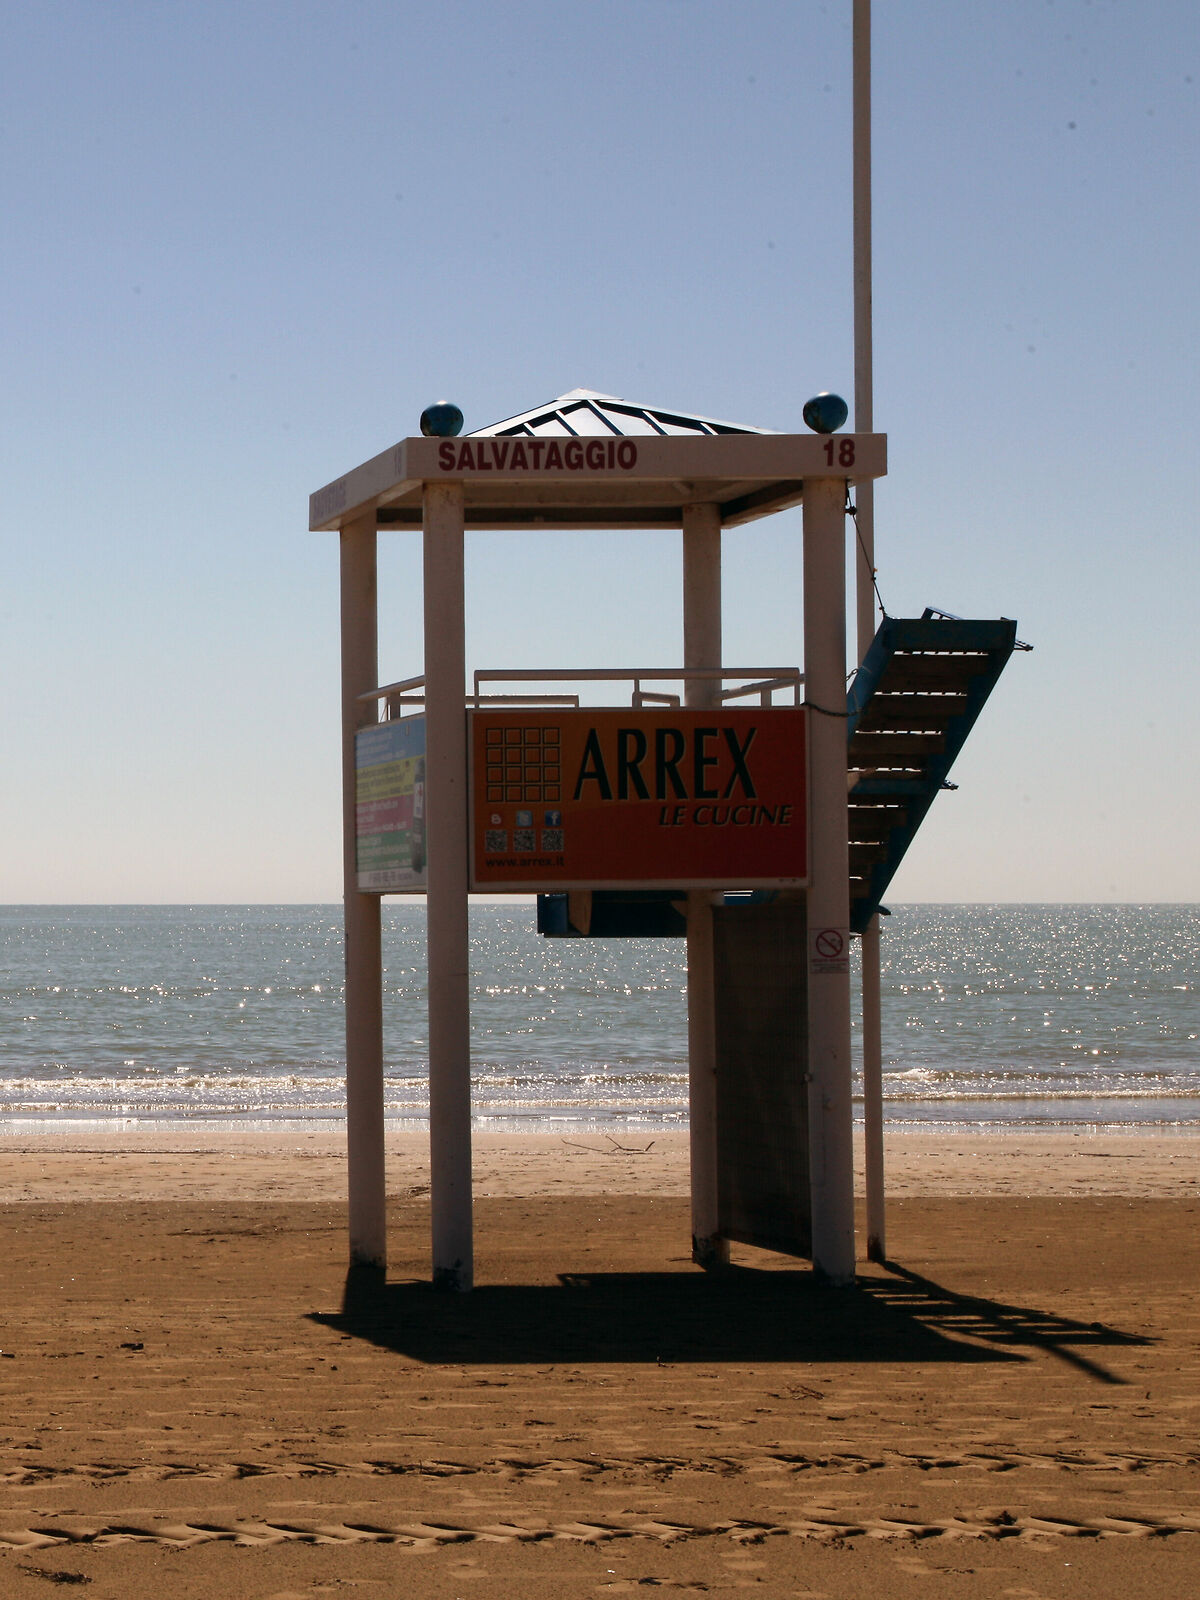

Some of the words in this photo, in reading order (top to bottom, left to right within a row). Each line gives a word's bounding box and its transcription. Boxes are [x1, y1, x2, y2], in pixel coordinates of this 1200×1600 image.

[438, 440, 638, 471] SALVATAGGIO
[824, 439, 856, 468] 18
[573, 728, 757, 800] ARREX
[658, 806, 687, 826] LE
[693, 804, 793, 826] CUCINE
[485, 856, 565, 868] www.arrex.it
